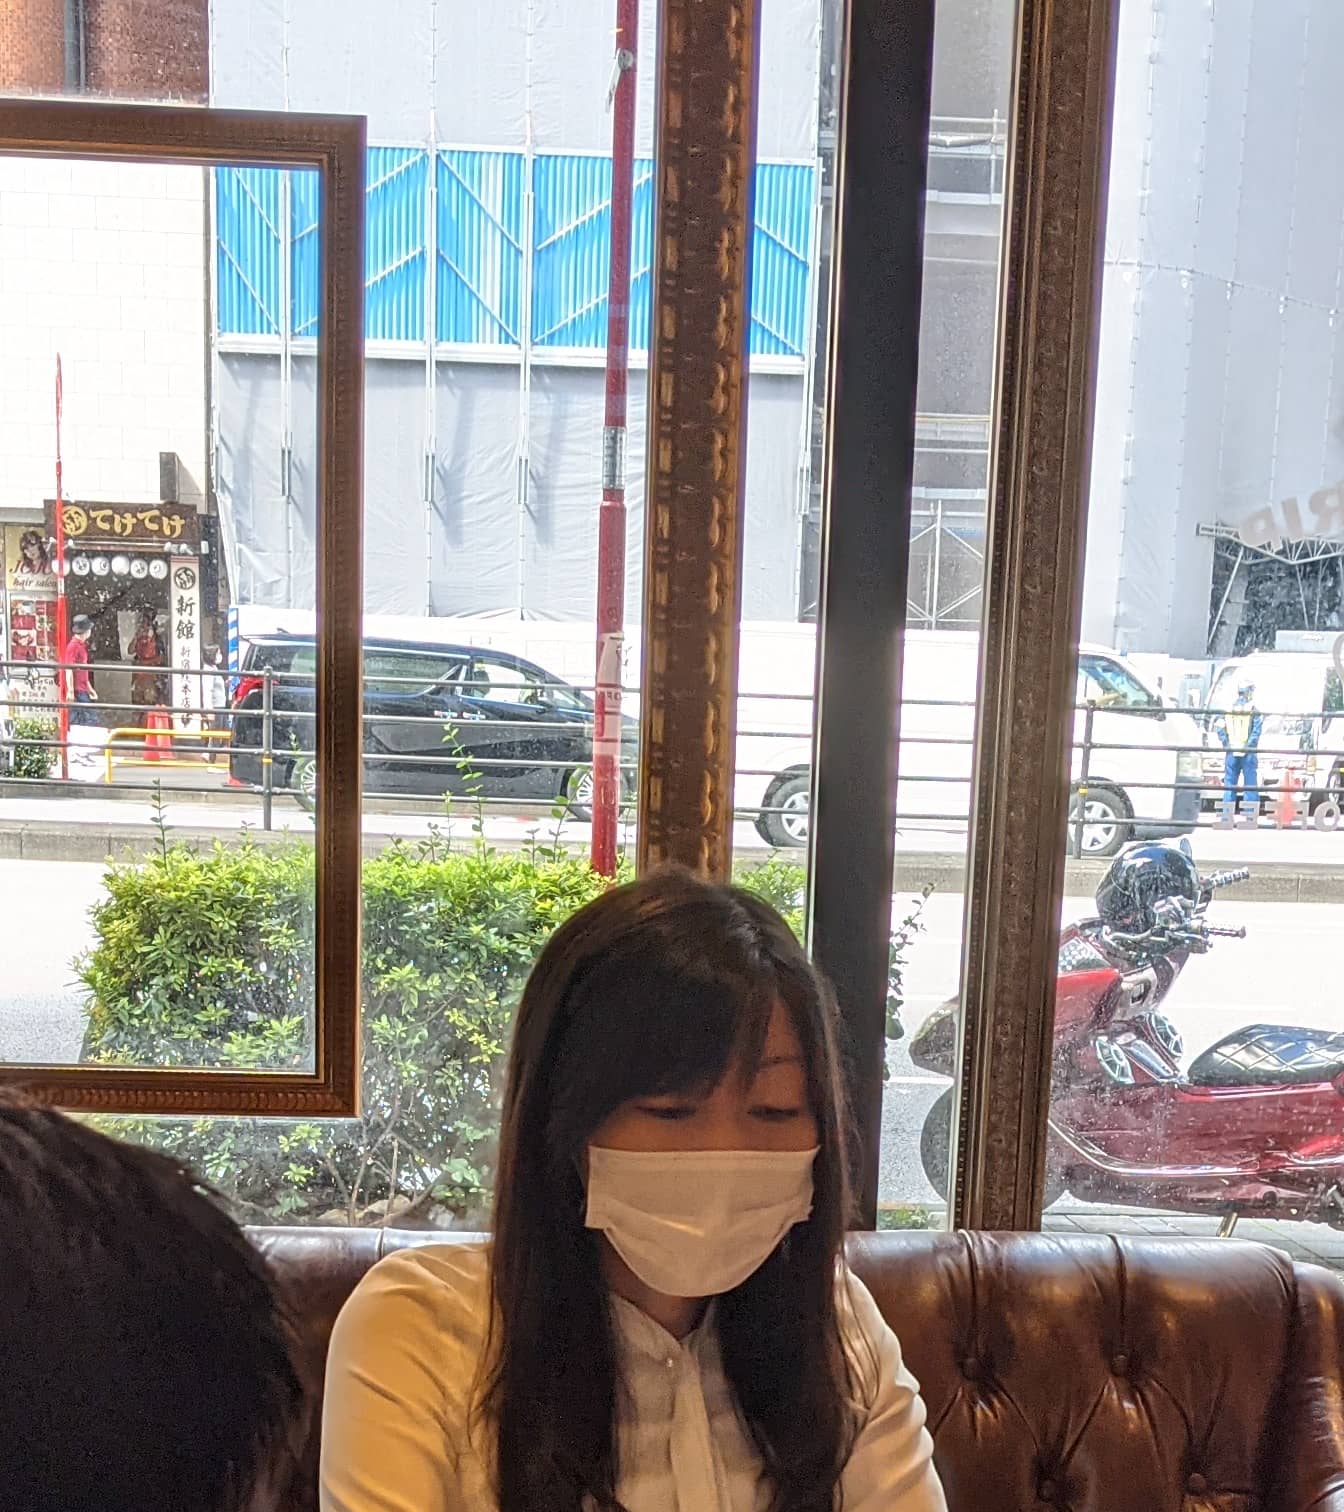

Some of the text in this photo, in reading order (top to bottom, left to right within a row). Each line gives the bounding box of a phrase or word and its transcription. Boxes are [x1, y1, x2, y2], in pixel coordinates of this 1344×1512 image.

[89, 509, 186, 538] てけてけ
[175, 595, 196, 640] 新館
